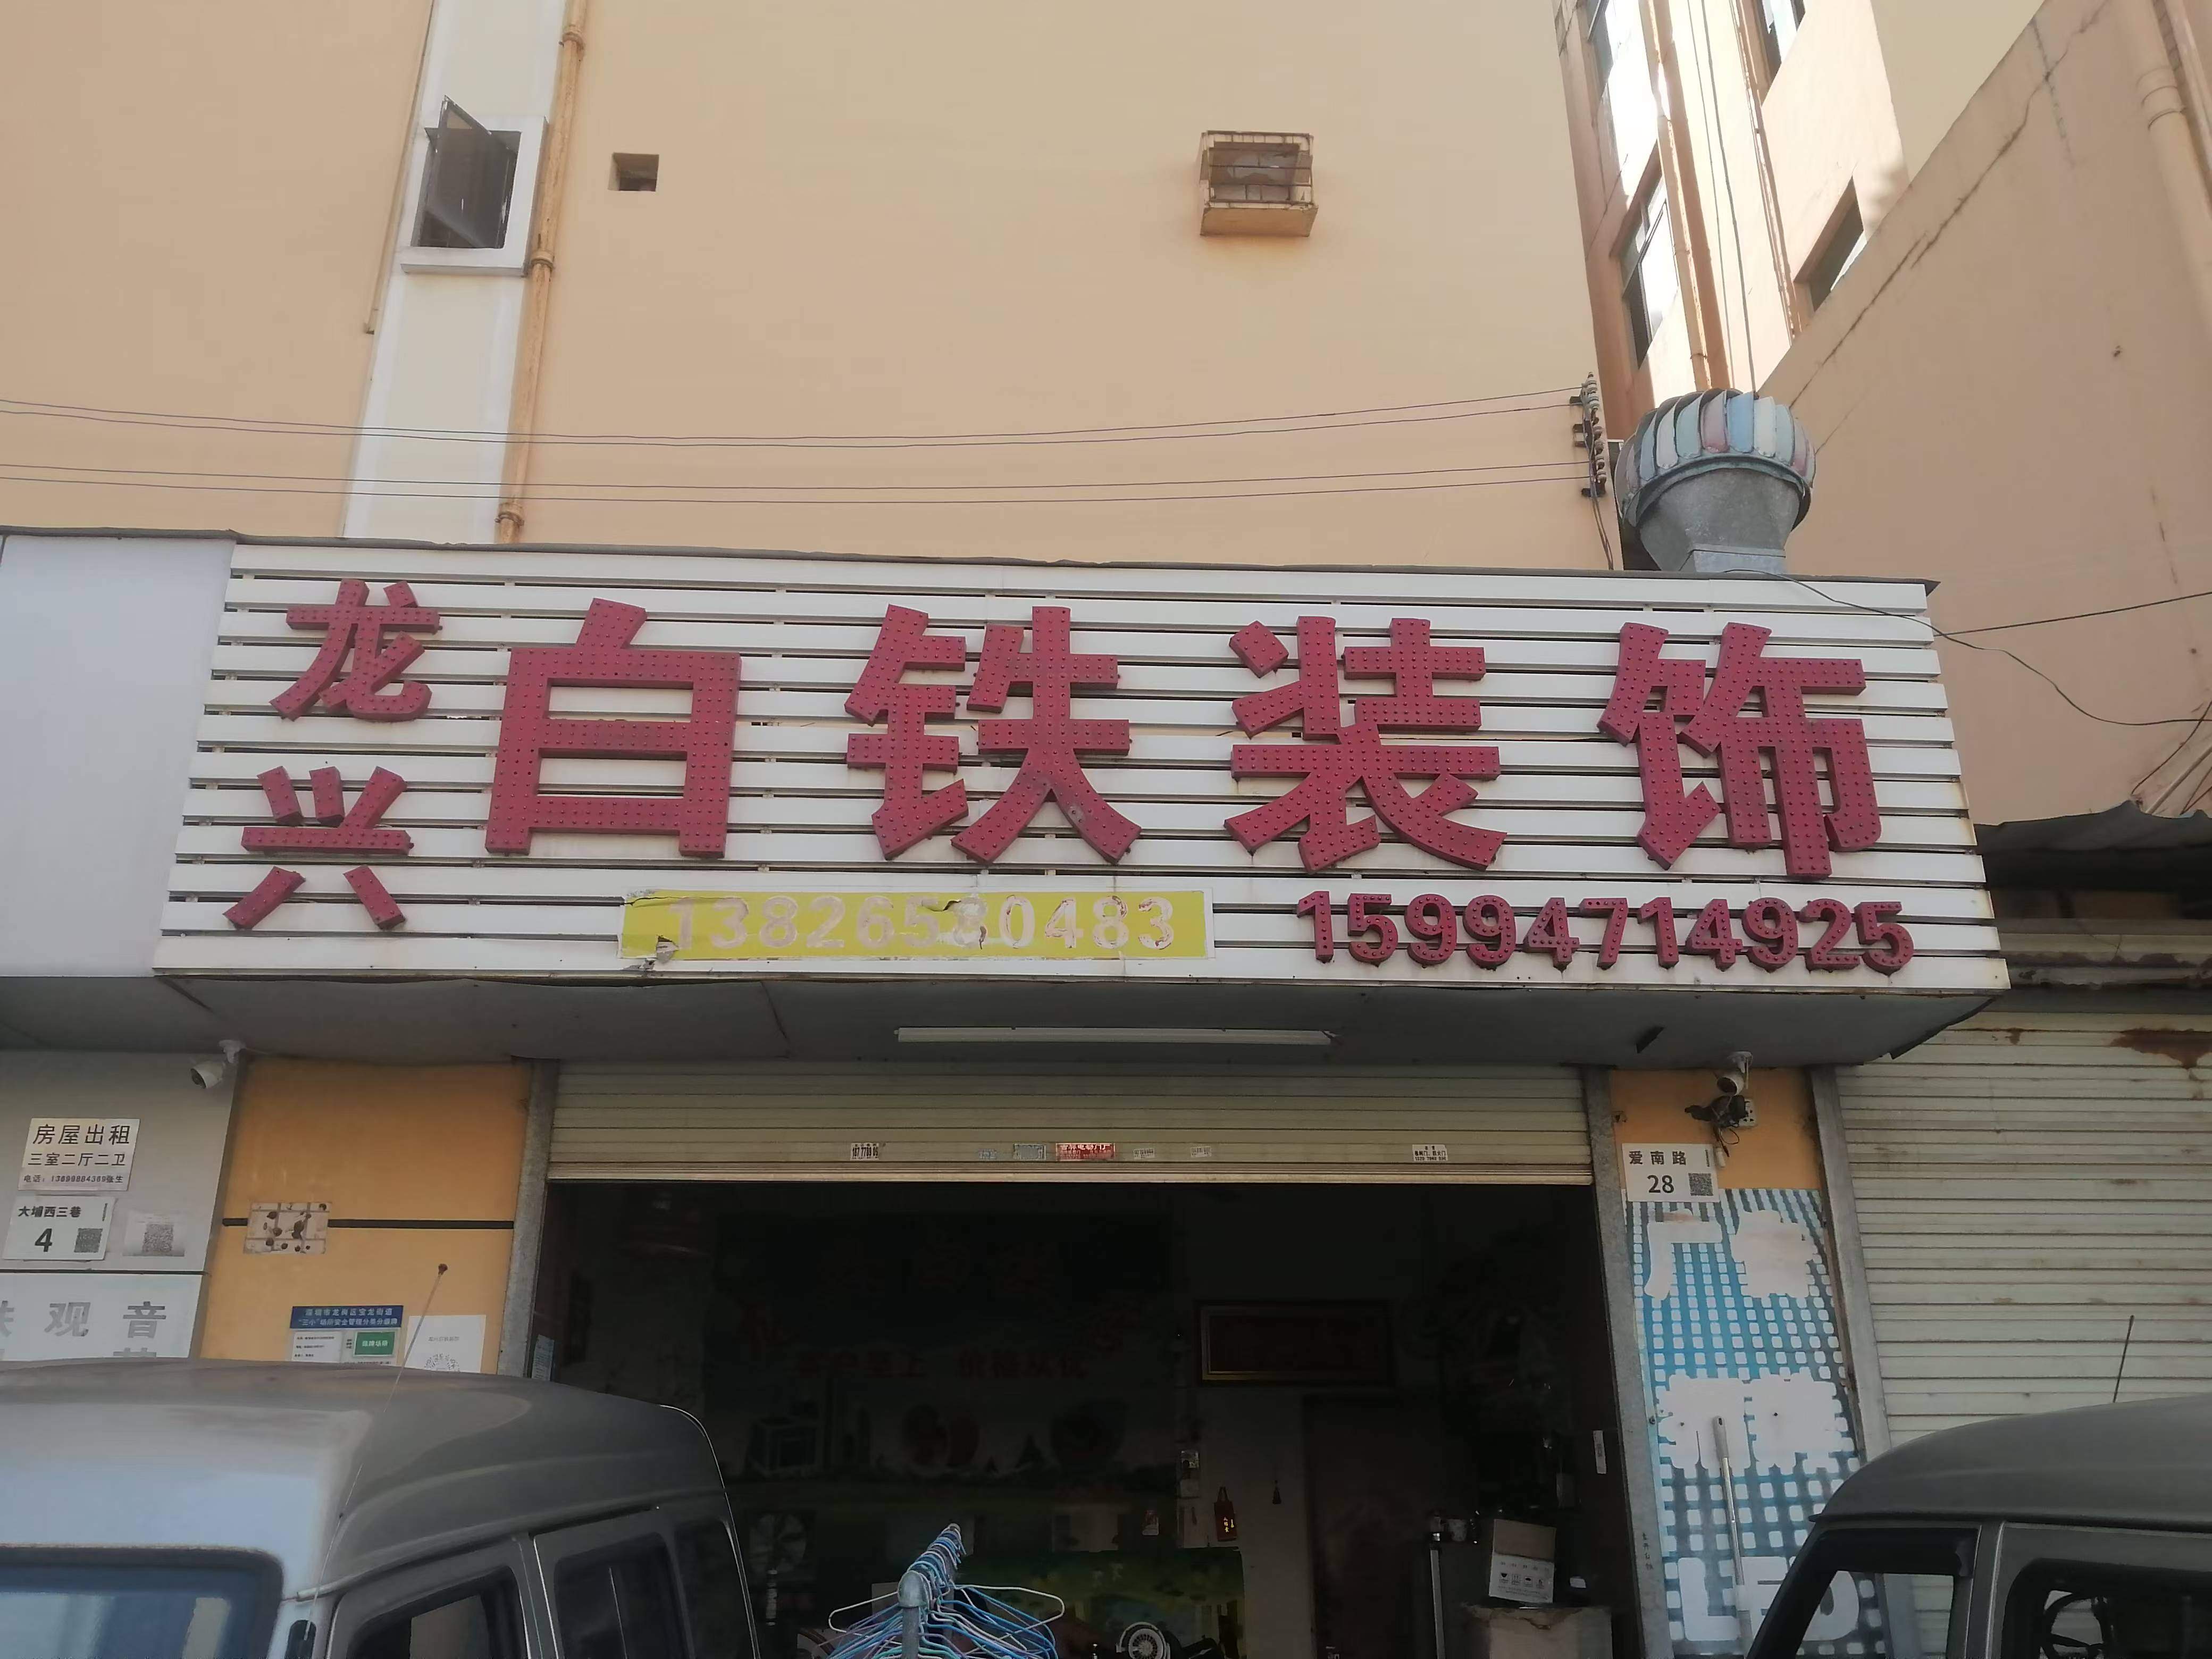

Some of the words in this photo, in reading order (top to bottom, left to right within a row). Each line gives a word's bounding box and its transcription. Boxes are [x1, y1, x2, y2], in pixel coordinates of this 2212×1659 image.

[485, 598, 1881, 880] 白铁装饰
[222, 578, 442, 929] 龙兴
[1296, 891, 1914, 974] 15994714925
[33, 1124, 130, 1145] 房屋出租
[28, 1152, 125, 1166] 三室二厅二卫
[1629, 1151, 1686, 1165] 爱南路
[1647, 1175, 1674, 1193] 28
[35, 1228, 53, 1252] 4
